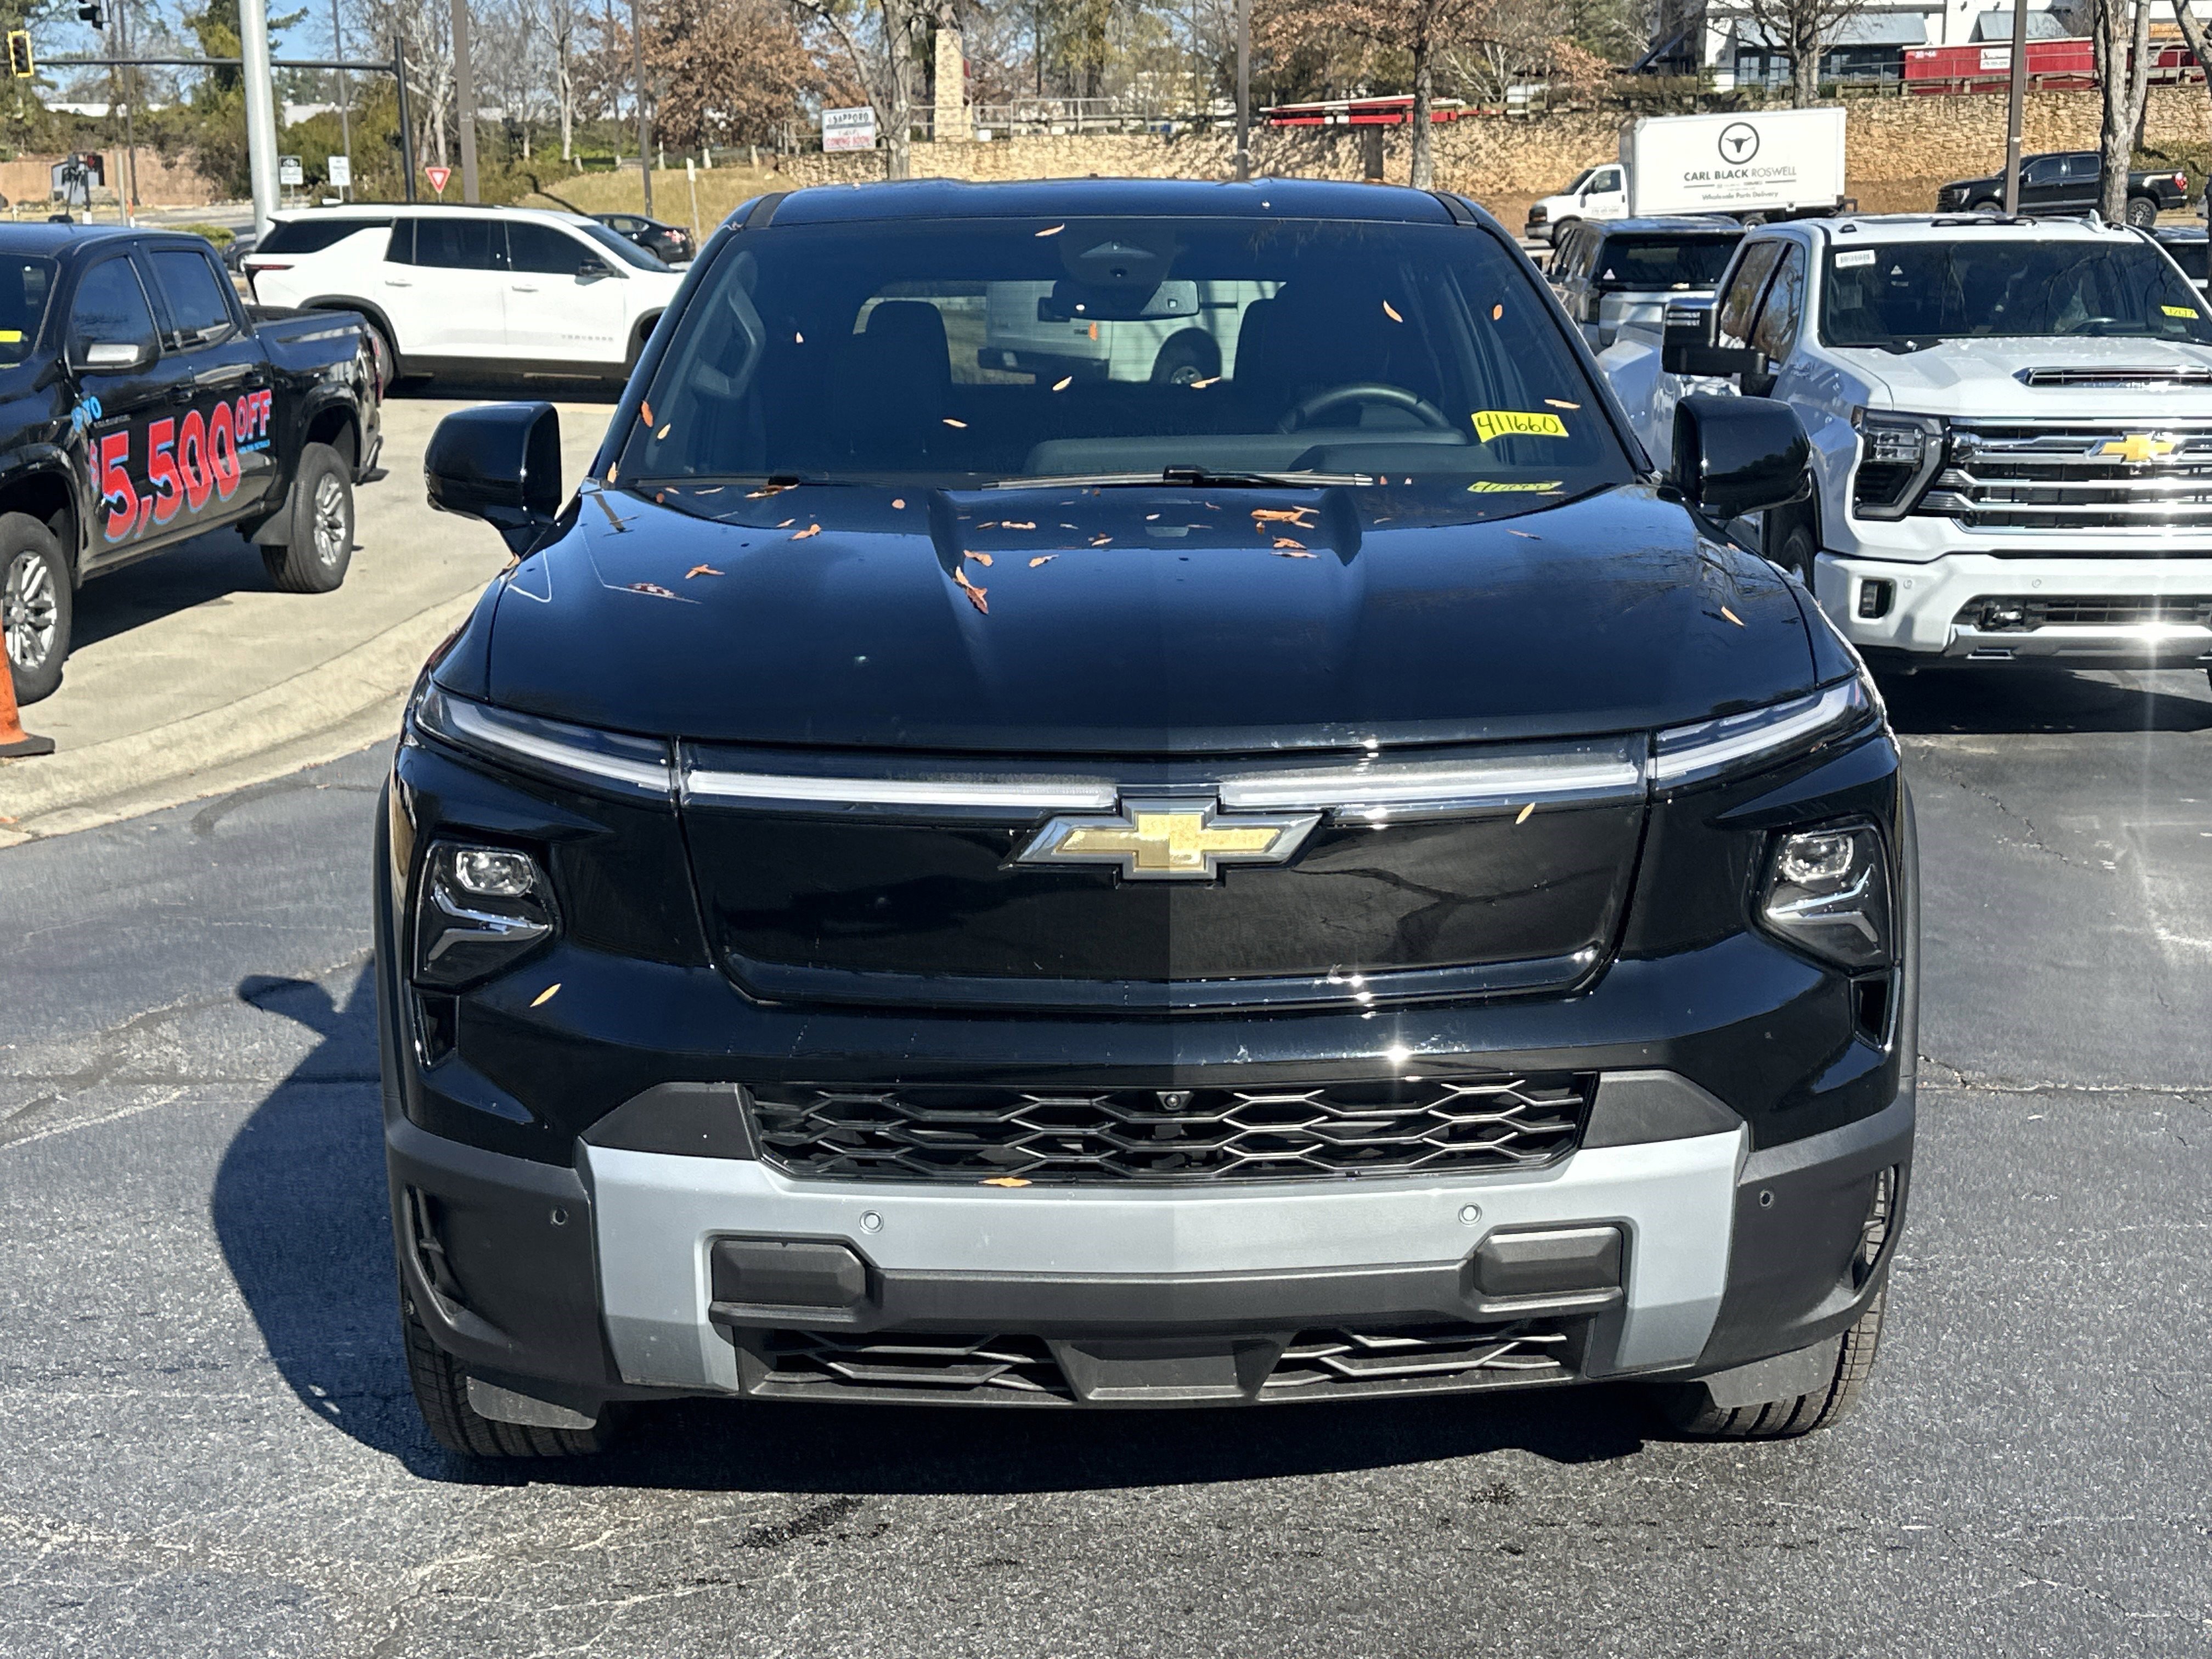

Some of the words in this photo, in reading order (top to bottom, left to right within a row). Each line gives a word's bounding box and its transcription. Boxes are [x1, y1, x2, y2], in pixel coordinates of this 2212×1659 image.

[1684, 171, 1711, 181] CARL
[1714, 169, 1748, 179] BLACK
[1751, 166, 1797, 177] ROSWELL
[235, 388, 272, 443] OFF
[1477, 413, 1559, 435] 411660
